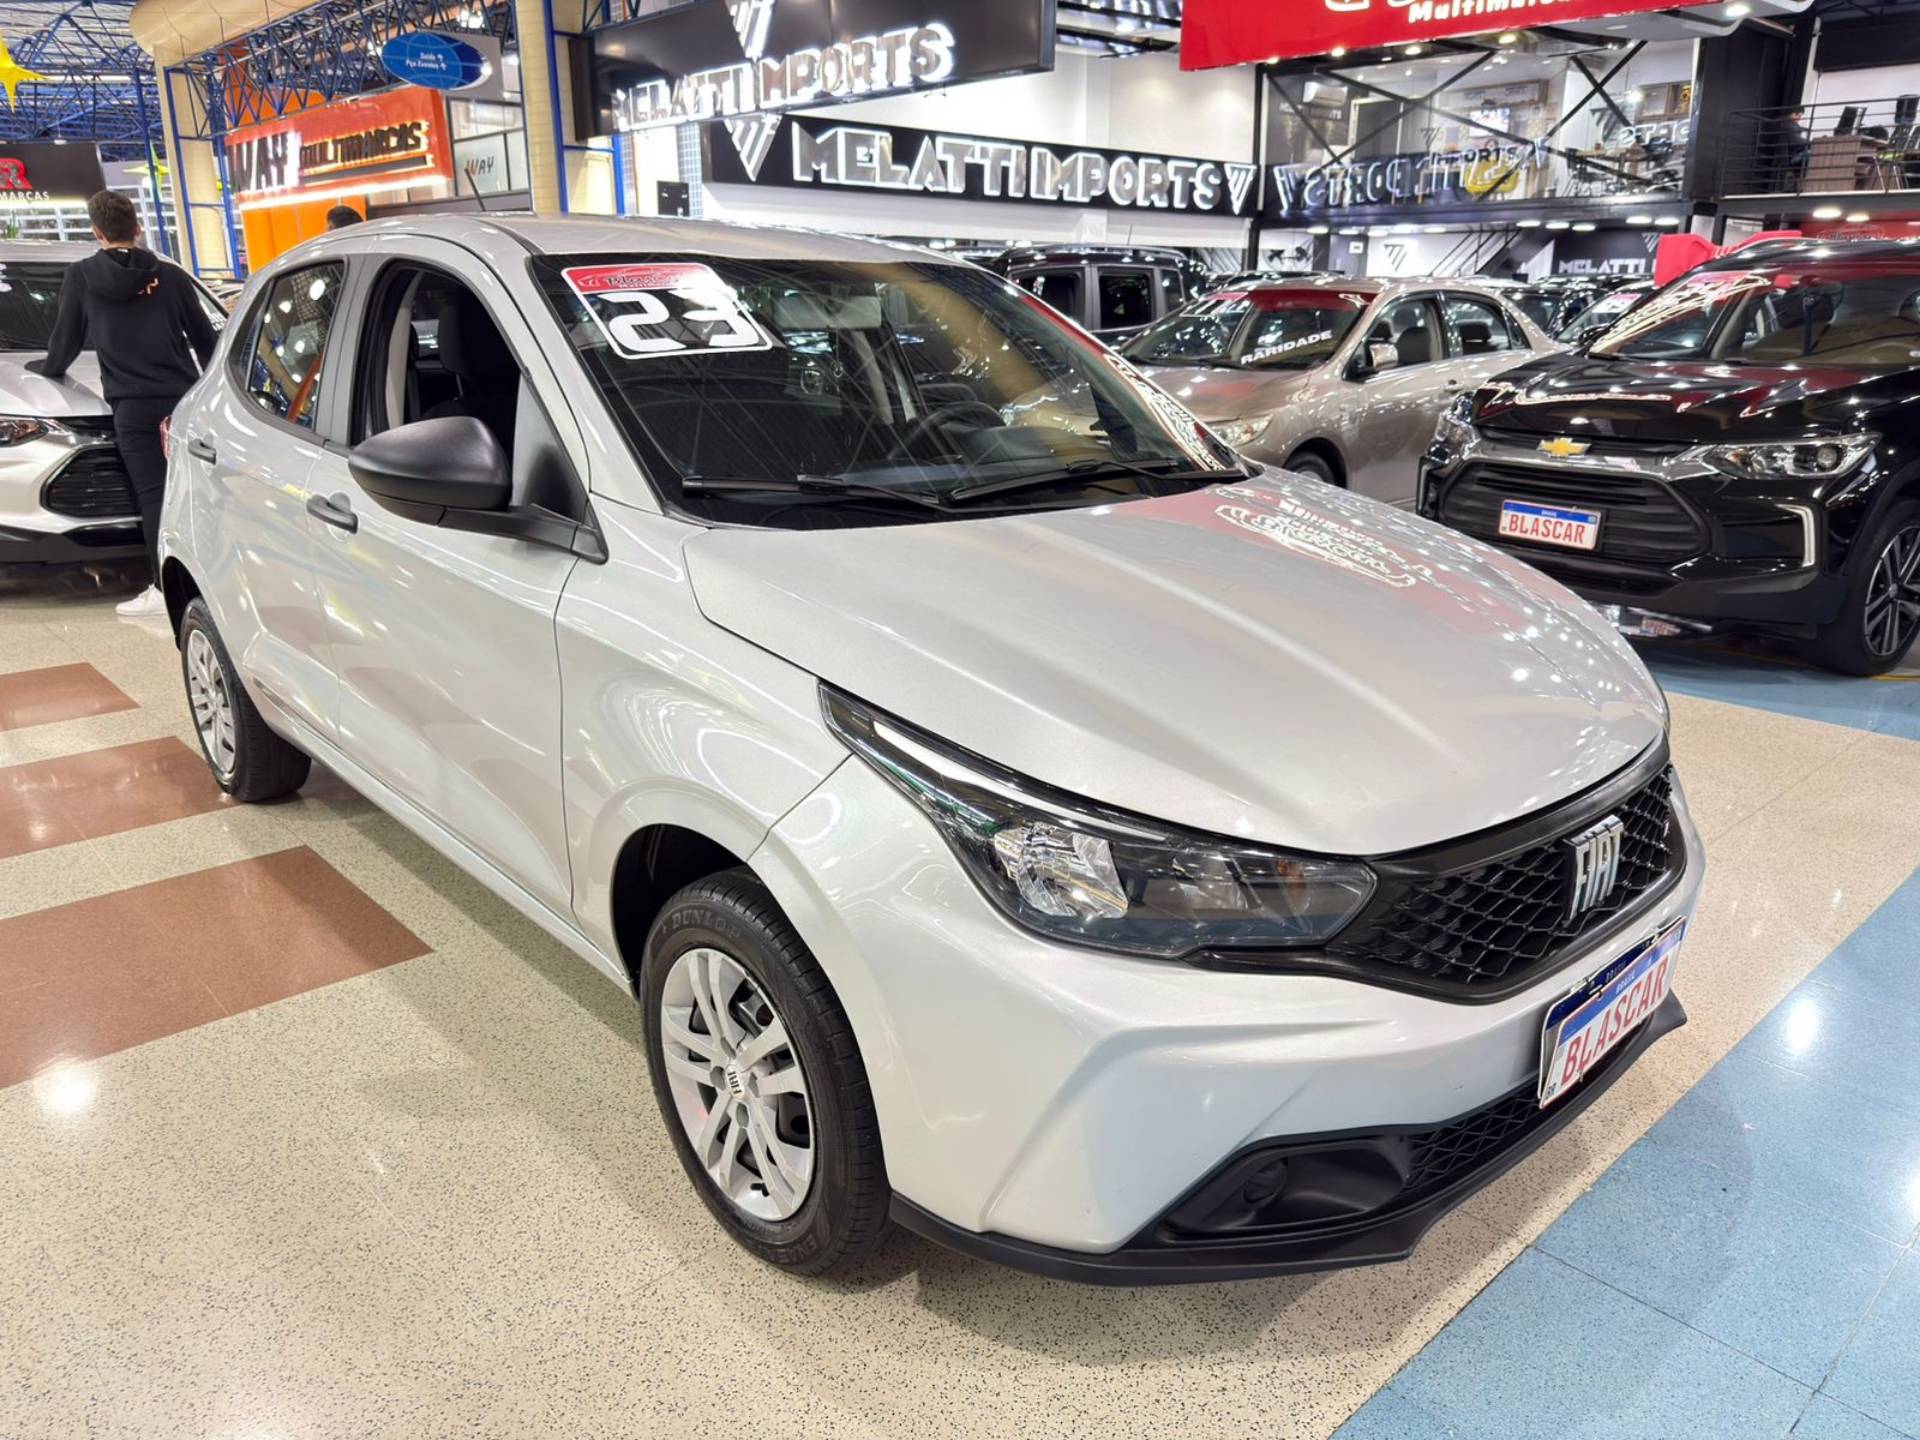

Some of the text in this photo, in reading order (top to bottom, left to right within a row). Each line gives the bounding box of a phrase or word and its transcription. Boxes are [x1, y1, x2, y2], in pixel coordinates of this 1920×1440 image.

[758, 24, 955, 109] IMPORTS
[229, 121, 423, 194] WAY MULTIMARCAS
[465, 156, 495, 175] WAY
[791, 120, 1223, 211] MELATTI IMPORTS
[1558, 258, 1646, 275] MELATTI
[597, 287, 759, 352] 23
[1241, 330, 1332, 365] RARIDADE
[1509, 514, 1585, 543] BLASCAR
[671, 909, 742, 938] DUNLOP
[1561, 955, 1669, 1086] BLASCAR
